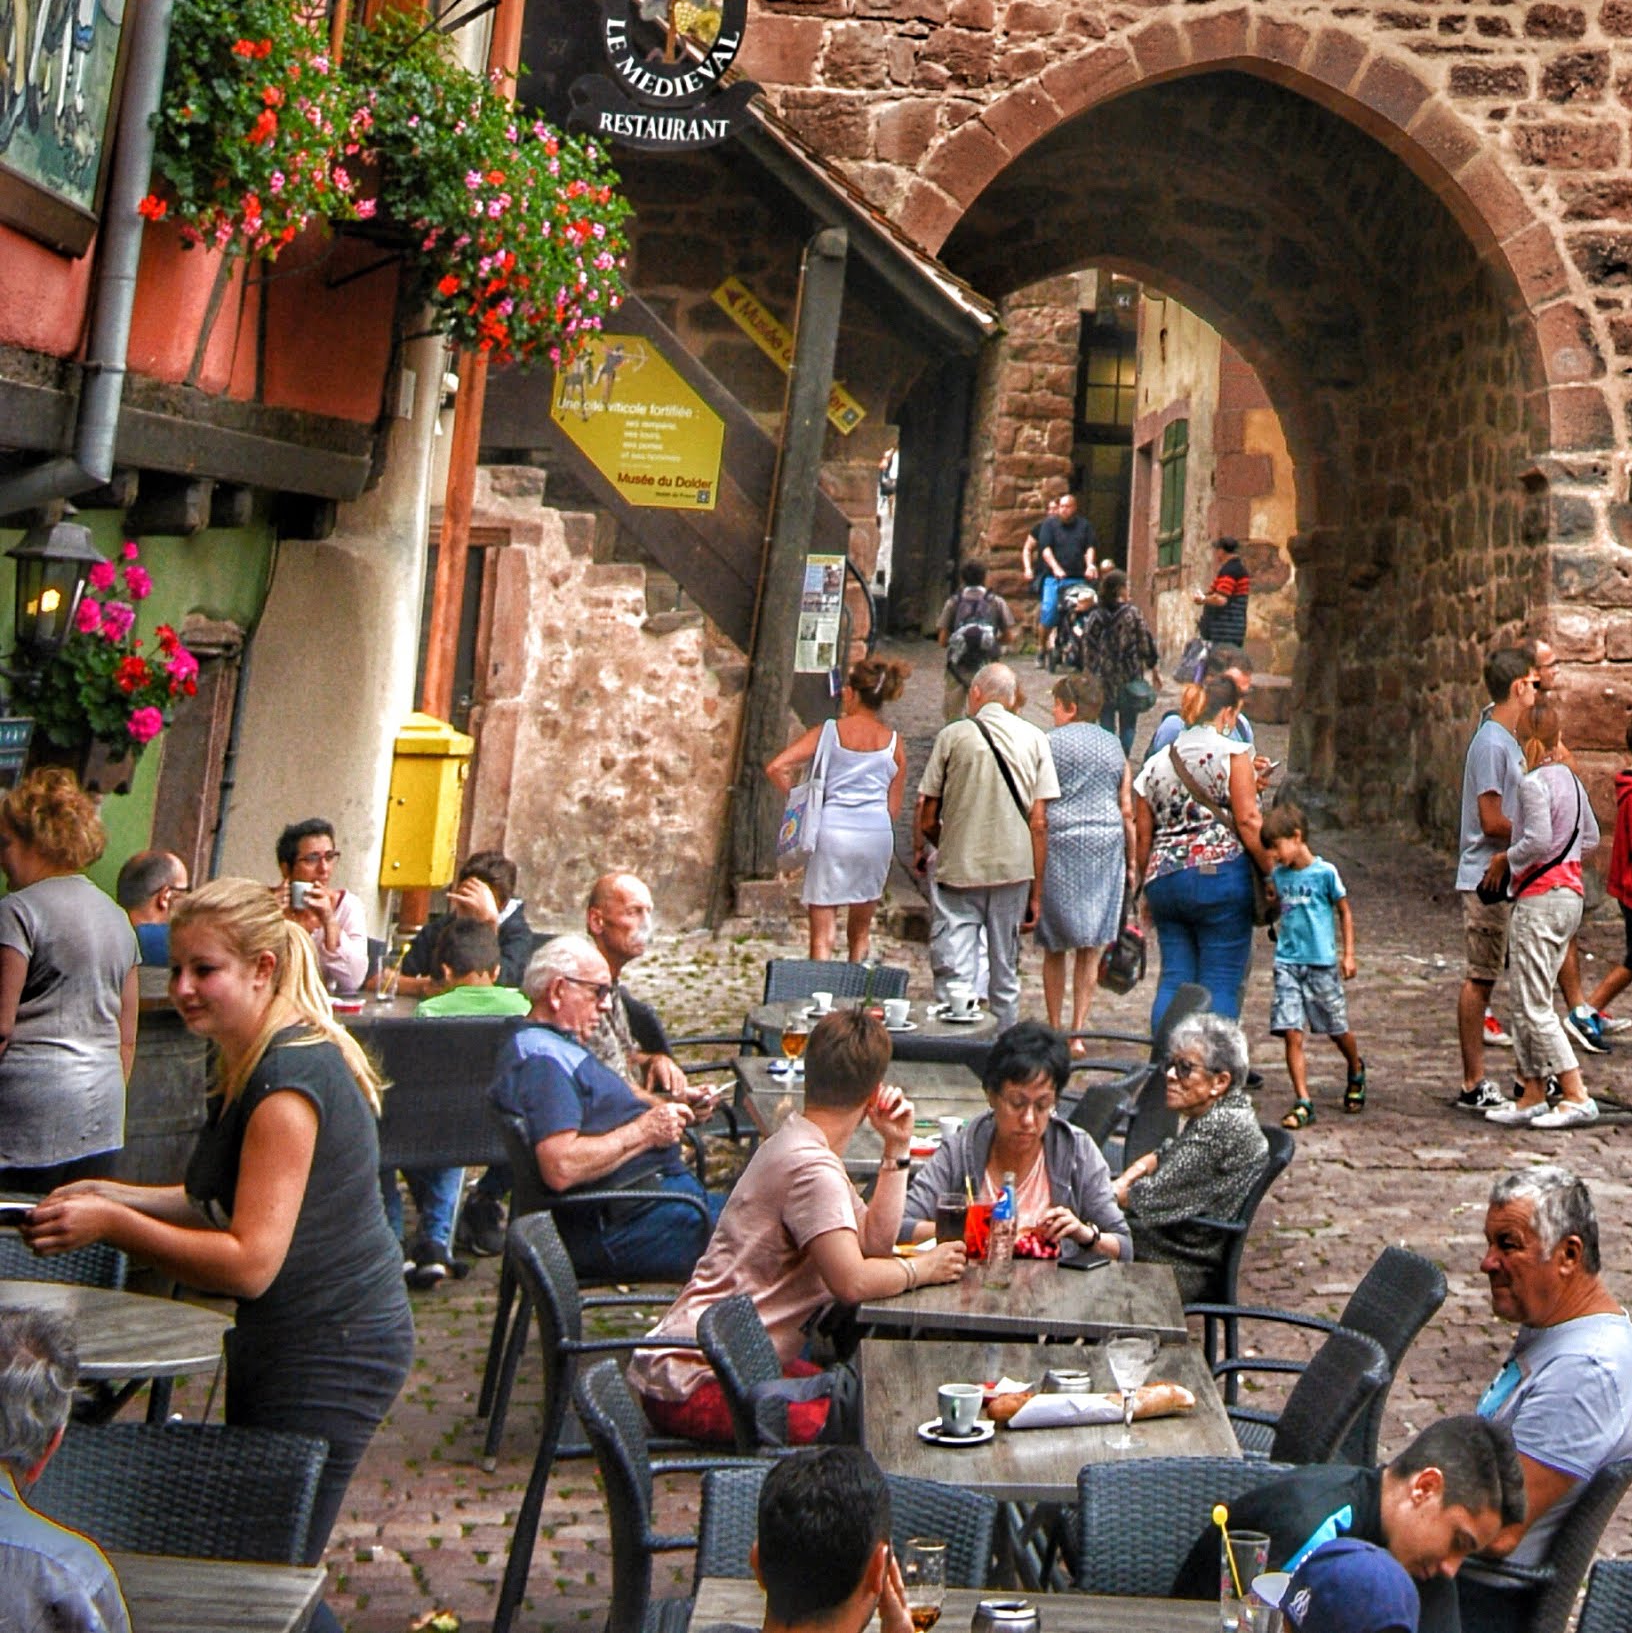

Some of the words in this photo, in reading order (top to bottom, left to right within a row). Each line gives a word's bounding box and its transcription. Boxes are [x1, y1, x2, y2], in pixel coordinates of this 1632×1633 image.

[606, 18, 628, 54] LE
[615, 30, 741, 98] MEDIEVAL
[599, 111, 730, 141] RESTAURANT
[618, 472, 655, 486] Musée
[657, 475, 673, 487] du
[675, 476, 713, 490] Dolder
